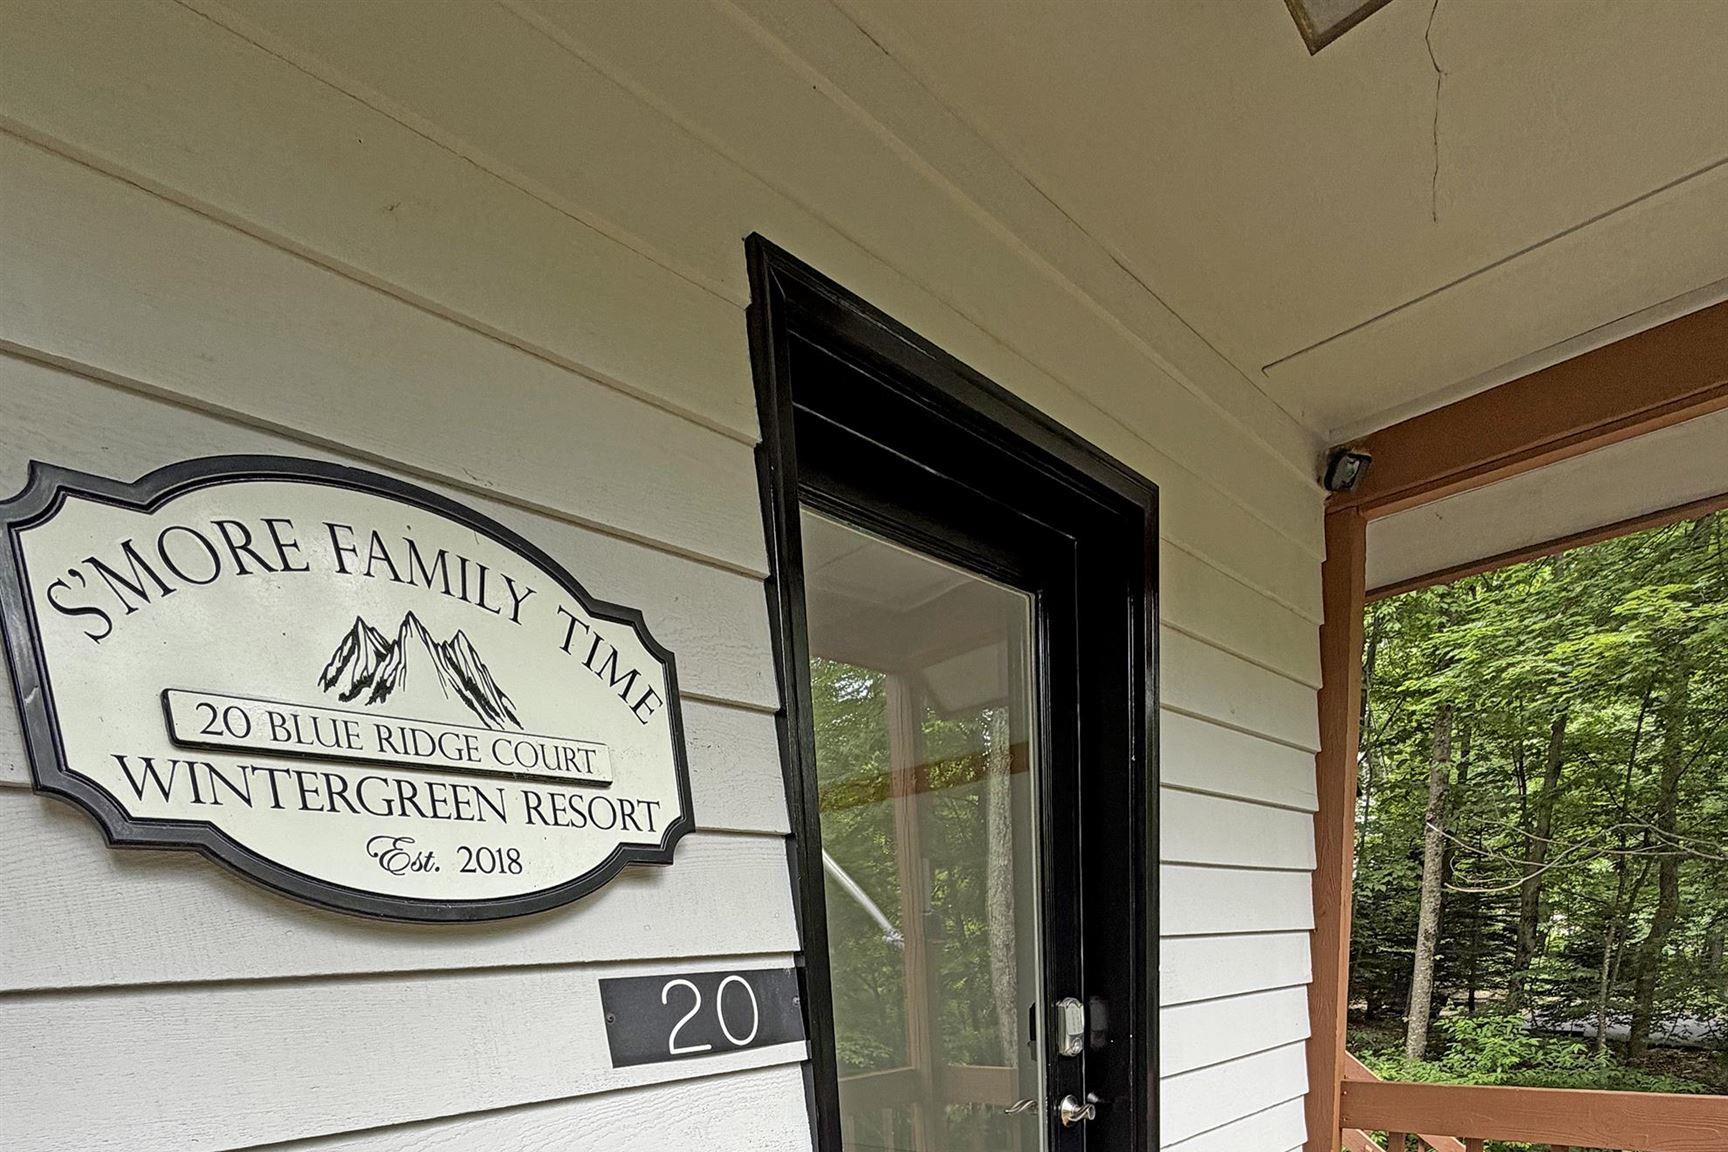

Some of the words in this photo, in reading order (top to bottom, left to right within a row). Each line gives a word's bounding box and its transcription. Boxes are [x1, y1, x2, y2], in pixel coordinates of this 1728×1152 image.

[47, 518, 309, 644] S'MORE
[323, 522, 537, 626] FAMILY
[557, 605, 663, 725] TIME
[196, 702, 251, 738] 20
[265, 711, 363, 750] BLUE
[375, 723, 482, 763] RIDGE
[491, 738, 596, 774] COURT
[112, 754, 508, 824] WINTERGREEN
[521, 790, 661, 832] RESORT
[366, 835, 440, 876] Est.
[456, 845, 523, 875] 2018
[661, 975, 759, 1054] 20
